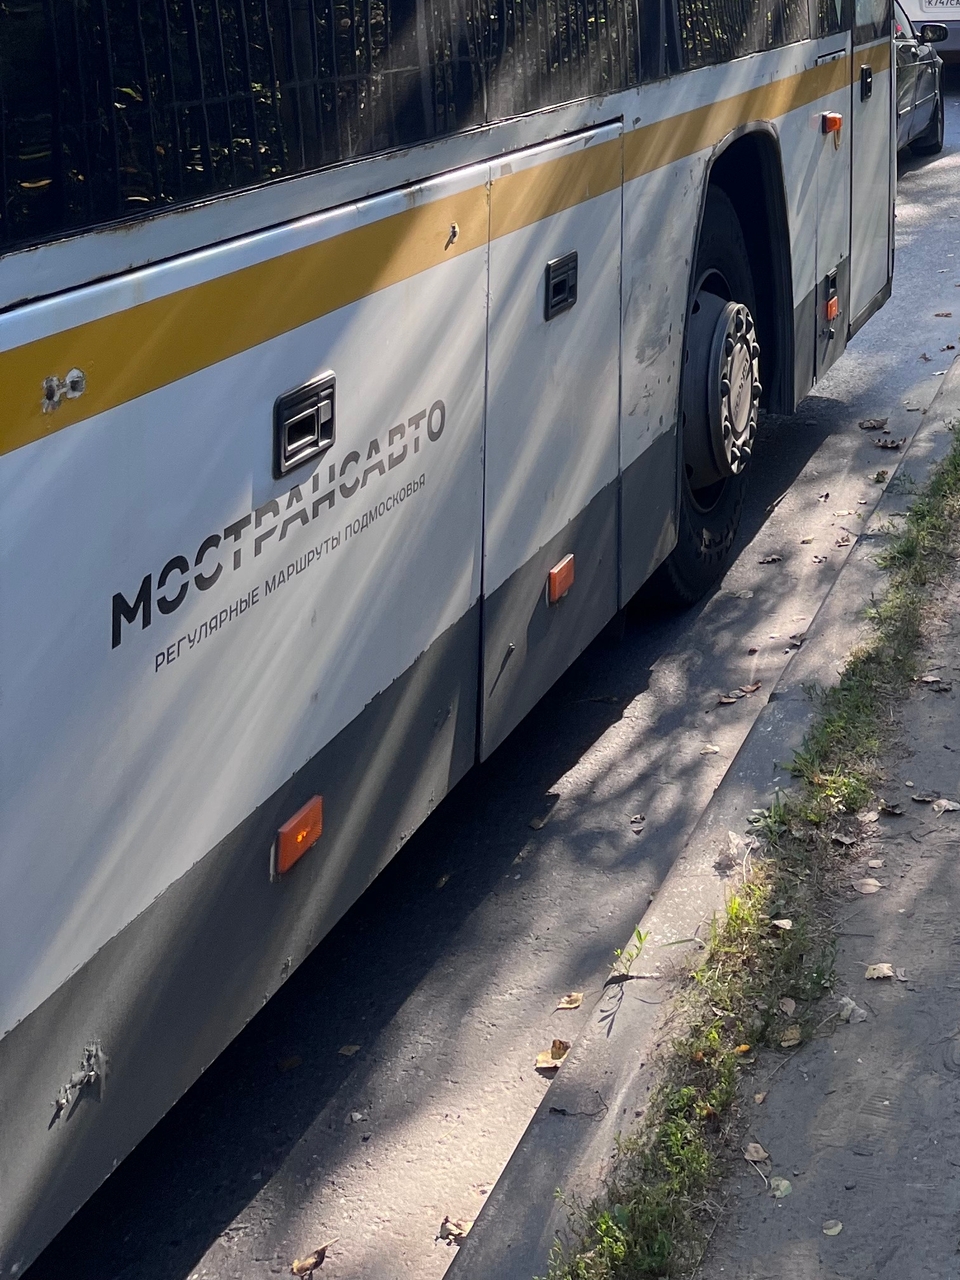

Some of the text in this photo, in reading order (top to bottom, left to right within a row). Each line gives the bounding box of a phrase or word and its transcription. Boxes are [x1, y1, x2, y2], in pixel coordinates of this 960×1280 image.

[111, 400, 446, 650] МОСТРАНСАВТО
[155, 472, 426, 672] РЕГУЛЯРНЫЕ МАРШРУТЫ ПОДМОСКОВЬЯ
